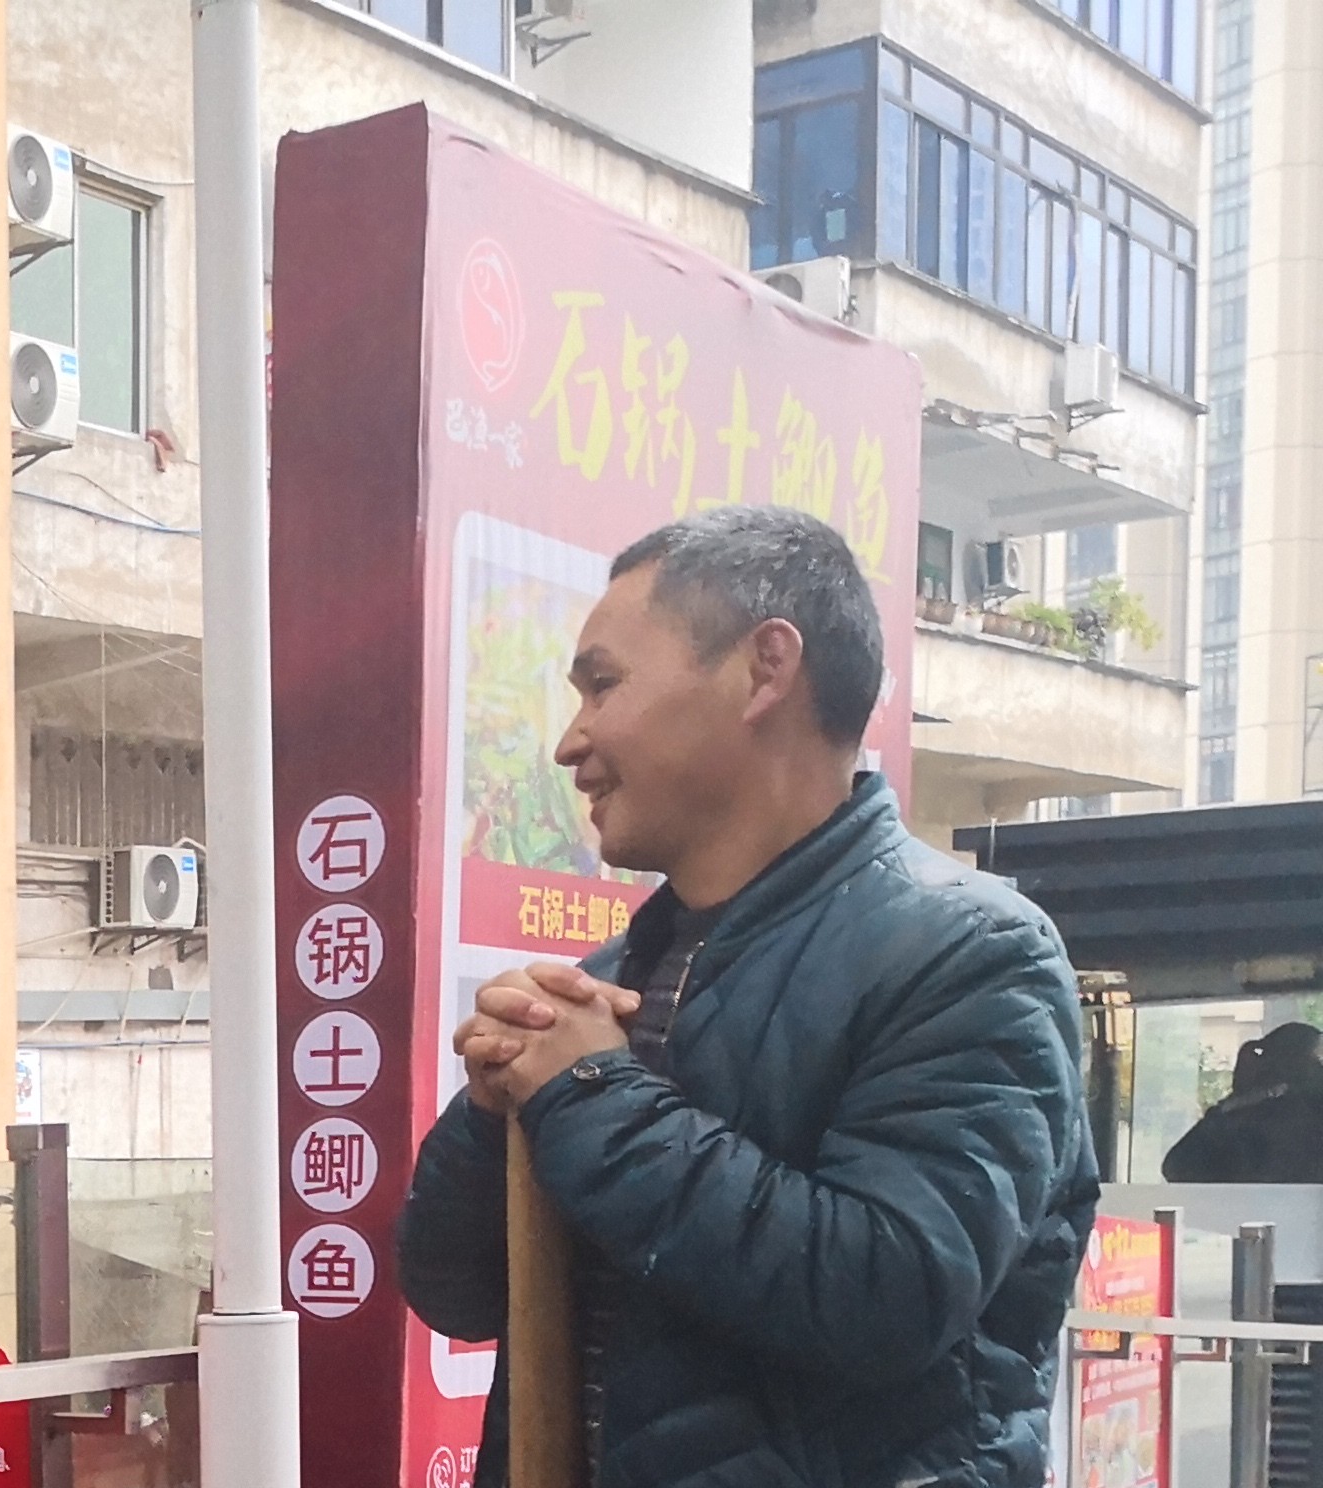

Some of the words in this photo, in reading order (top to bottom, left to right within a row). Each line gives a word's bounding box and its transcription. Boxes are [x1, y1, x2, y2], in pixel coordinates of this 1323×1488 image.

[518, 884, 630, 944] 石锅土鲫鱼
[299, 811, 372, 1306] 石锅土鲫鱼
